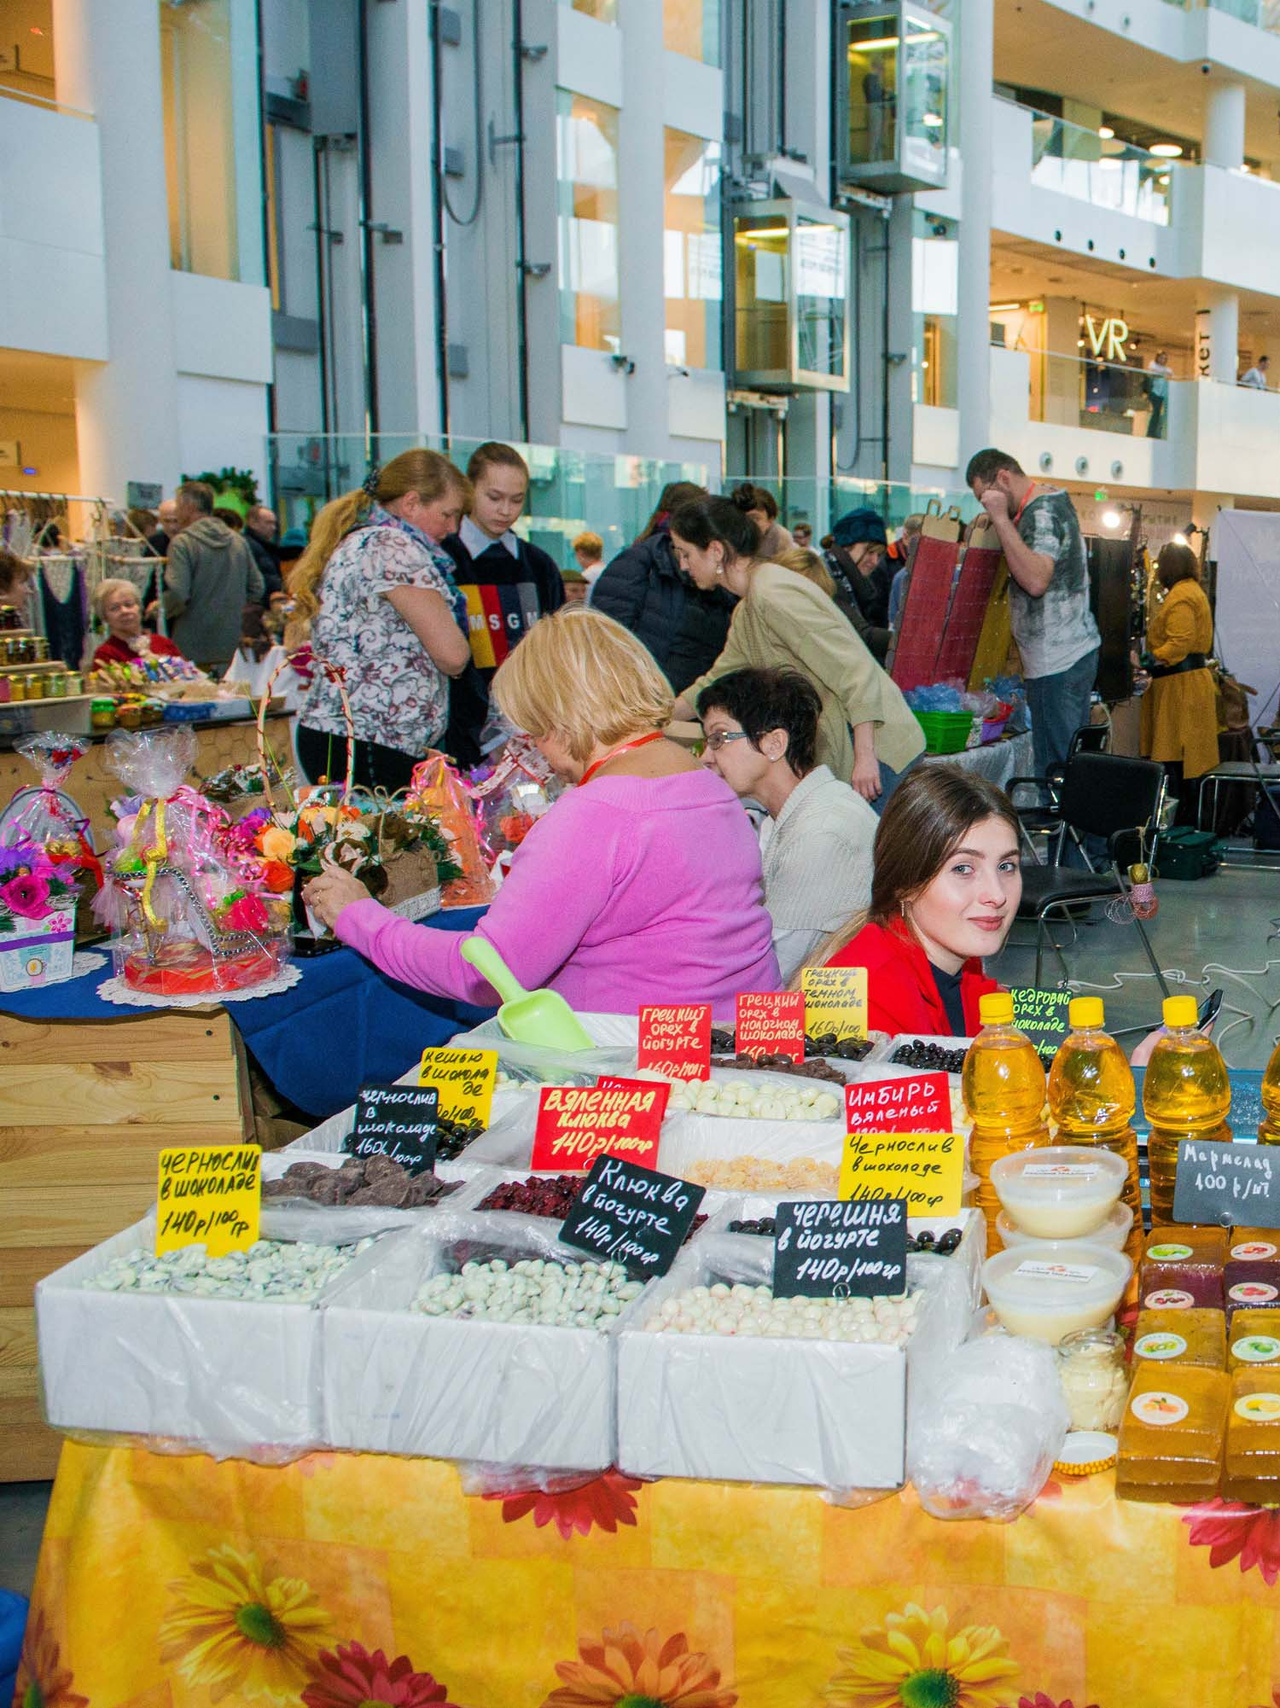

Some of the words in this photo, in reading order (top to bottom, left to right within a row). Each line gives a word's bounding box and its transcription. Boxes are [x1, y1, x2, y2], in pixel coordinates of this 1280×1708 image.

[1085, 314, 1128, 362] VR
[425, 1051, 483, 1064] кешью
[544, 1090, 656, 1113] ВЯЛЕННАЯ
[848, 1083, 935, 1107] ИМБИРЬ
[557, 1111, 631, 1129] клюква
[851, 1100, 939, 1126] вяленый
[357, 1121, 436, 1143] шоколаде
[850, 1136, 955, 1156] Чернослив
[1184, 1144, 1272, 1180] Мармелад
[598, 1159, 690, 1212] Клюква
[593, 1192, 671, 1236] йогурте
